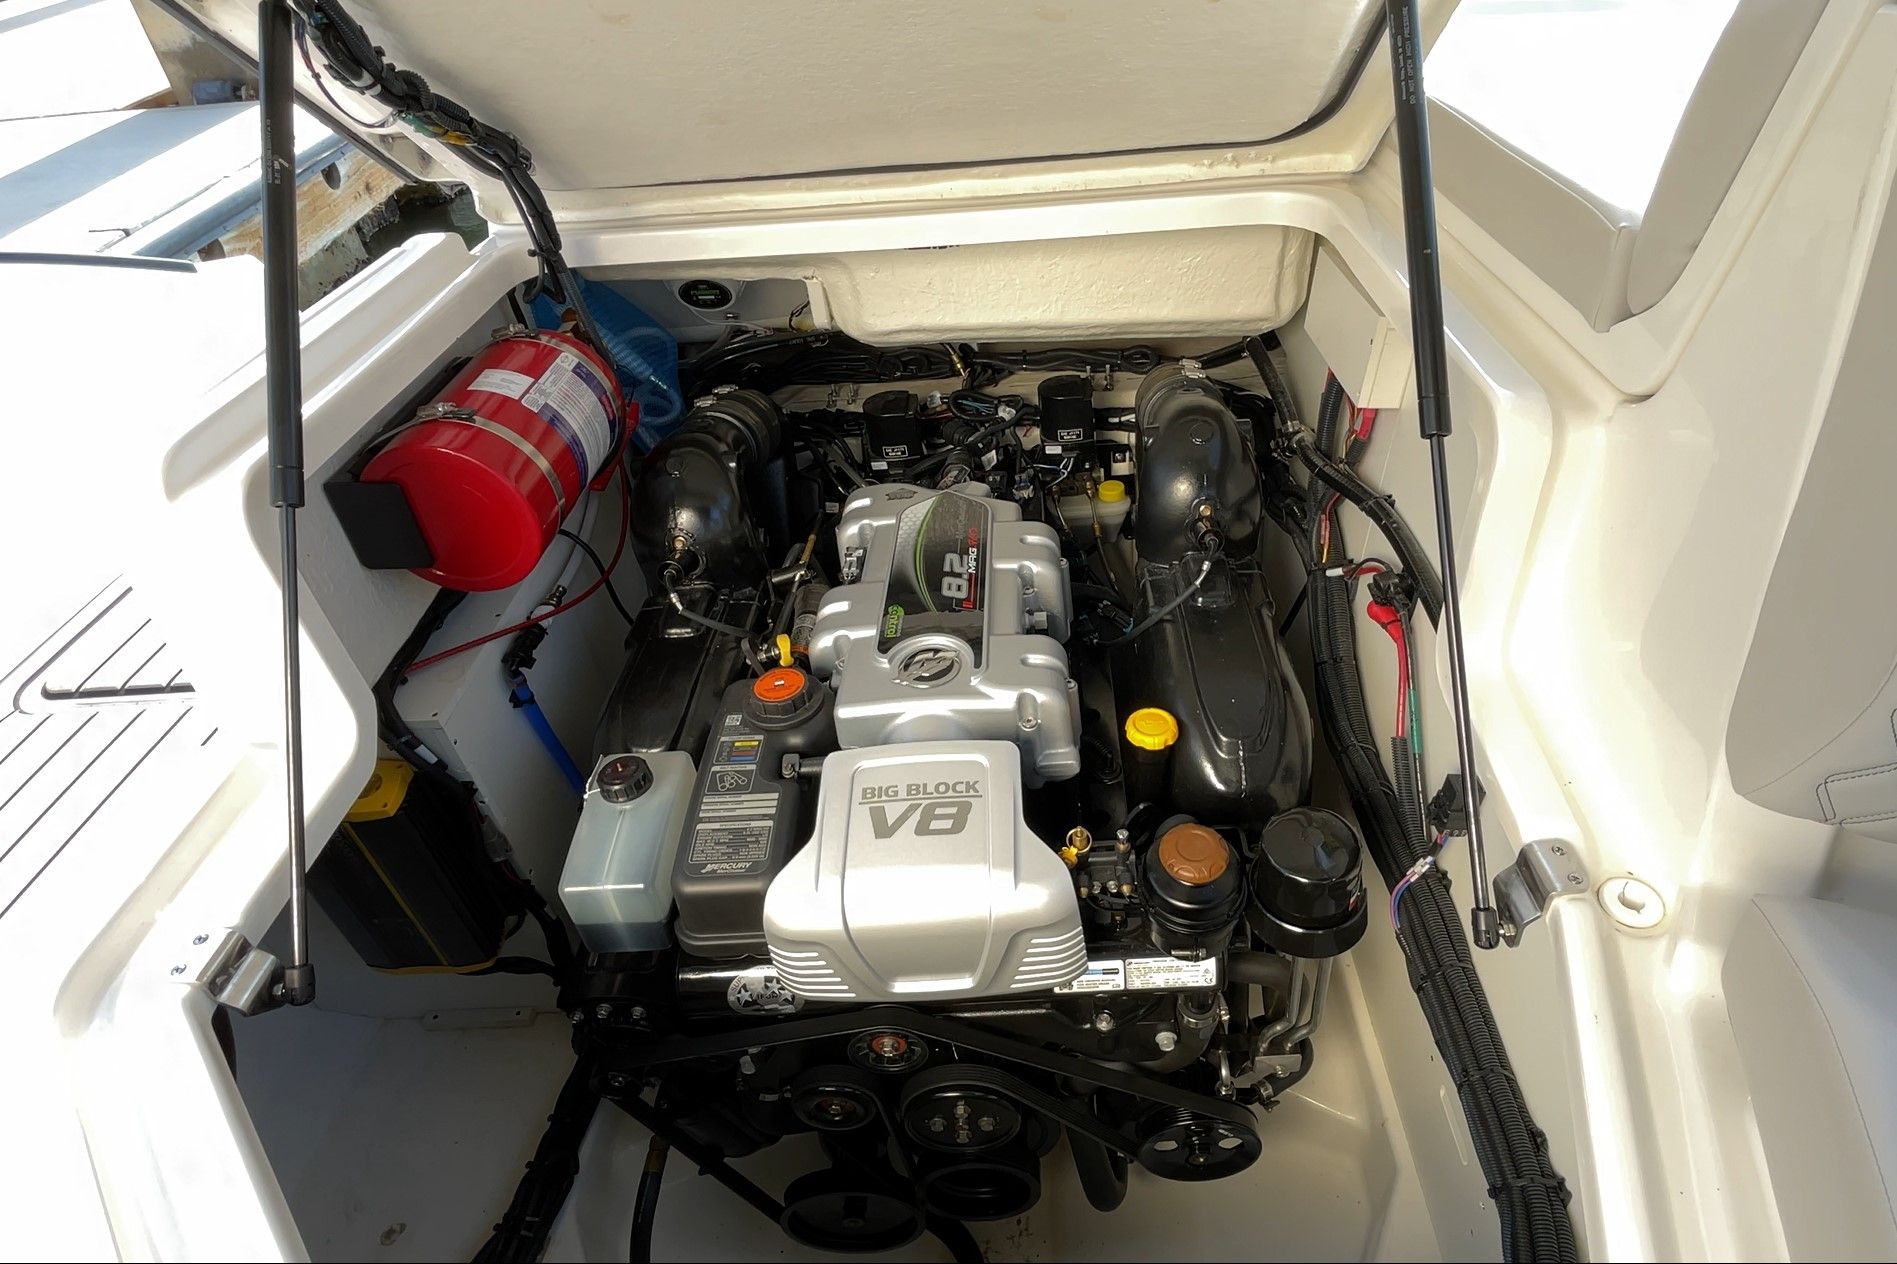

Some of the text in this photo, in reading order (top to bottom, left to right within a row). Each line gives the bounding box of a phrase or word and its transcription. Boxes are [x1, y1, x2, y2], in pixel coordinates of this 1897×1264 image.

[968, 547, 977, 574] MAG
[941, 552, 969, 600] 8.2
[861, 780, 980, 801] BIG BLOCK
[869, 800, 973, 839] V8
[701, 861, 752, 873] MERCURY
